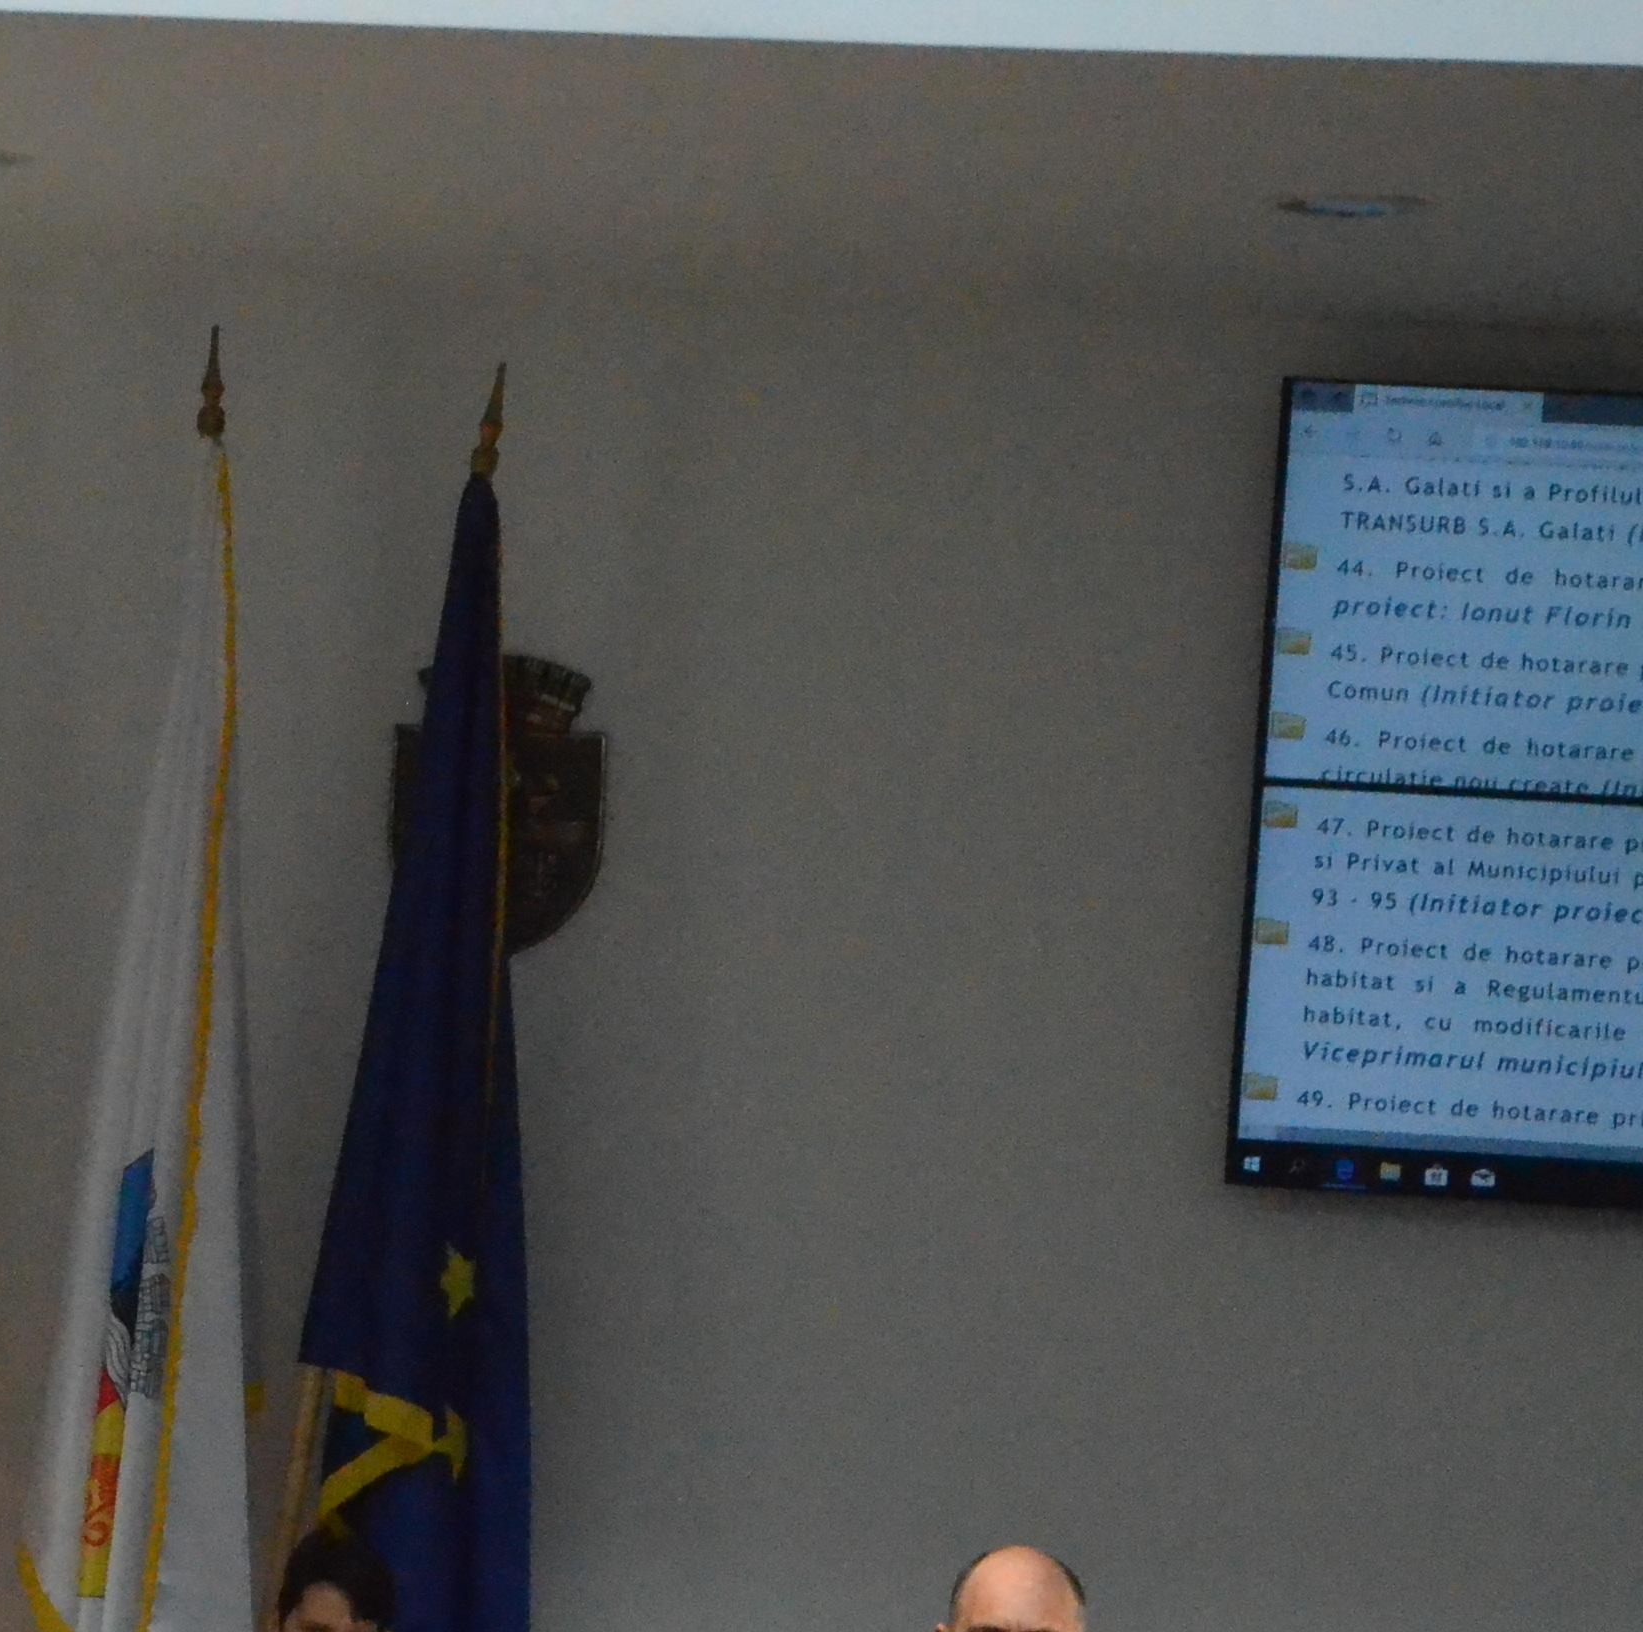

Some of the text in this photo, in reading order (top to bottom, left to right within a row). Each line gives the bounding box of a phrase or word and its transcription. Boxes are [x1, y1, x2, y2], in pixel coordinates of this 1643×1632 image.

[1344, 473, 1390, 493] S.A.
[1405, 476, 1480, 497] Galati
[1493, 482, 1511, 499] si
[1523, 486, 1535, 501] a
[1341, 511, 1466, 535] TRANSURB
[1479, 517, 1524, 538] S.A.
[1539, 520, 1614, 542] Galati
[1337, 559, 1372, 576] 44.
[1396, 561, 1483, 583] Proiect
[1505, 567, 1533, 585] de
[1332, 596, 1631, 629] proiect: Ionut Florin
[1330, 644, 1366, 662] 45.
[1380, 645, 1468, 668] Proiect
[1481, 651, 1509, 670] de
[1521, 652, 1628, 676] hotarare
[1327, 680, 1409, 702] Comun
[1421, 685, 1555, 709] (Initiator
[1324, 728, 1634, 762] 46. Proiect de hotarare
[1317, 818, 1352, 836] 47.
[1367, 819, 1454, 842] Proiect
[1467, 825, 1495, 844] de
[1507, 827, 1613, 851] hotarare
[1314, 855, 1332, 869] si
[1347, 852, 1418, 874] Privat
[1433, 858, 1454, 876] al
[1468, 861, 1619, 886] Municipiului
[1311, 888, 1338, 907] 93
[1371, 891, 1397, 911] 95
[1409, 893, 1542, 918] (Initiator
[1308, 935, 1343, 953] 48.
[1361, 937, 1447, 960] Proiect
[1463, 943, 1491, 962] de
[1506, 945, 1612, 970] hotarare
[1306, 968, 1394, 991] habitat
[1415, 976, 1433, 993] si
[1454, 981, 1466, 995] a
[1303, 1005, 1626, 1041] habitat, cu modificarile
[1304, 1041, 1485, 1070] Viceprimarul
[1297, 1090, 1332, 1108] 49.
[1348, 1092, 1436, 1115] Proiect
[1450, 1099, 1479, 1117] de
[1492, 1100, 1599, 1125] hotarare
